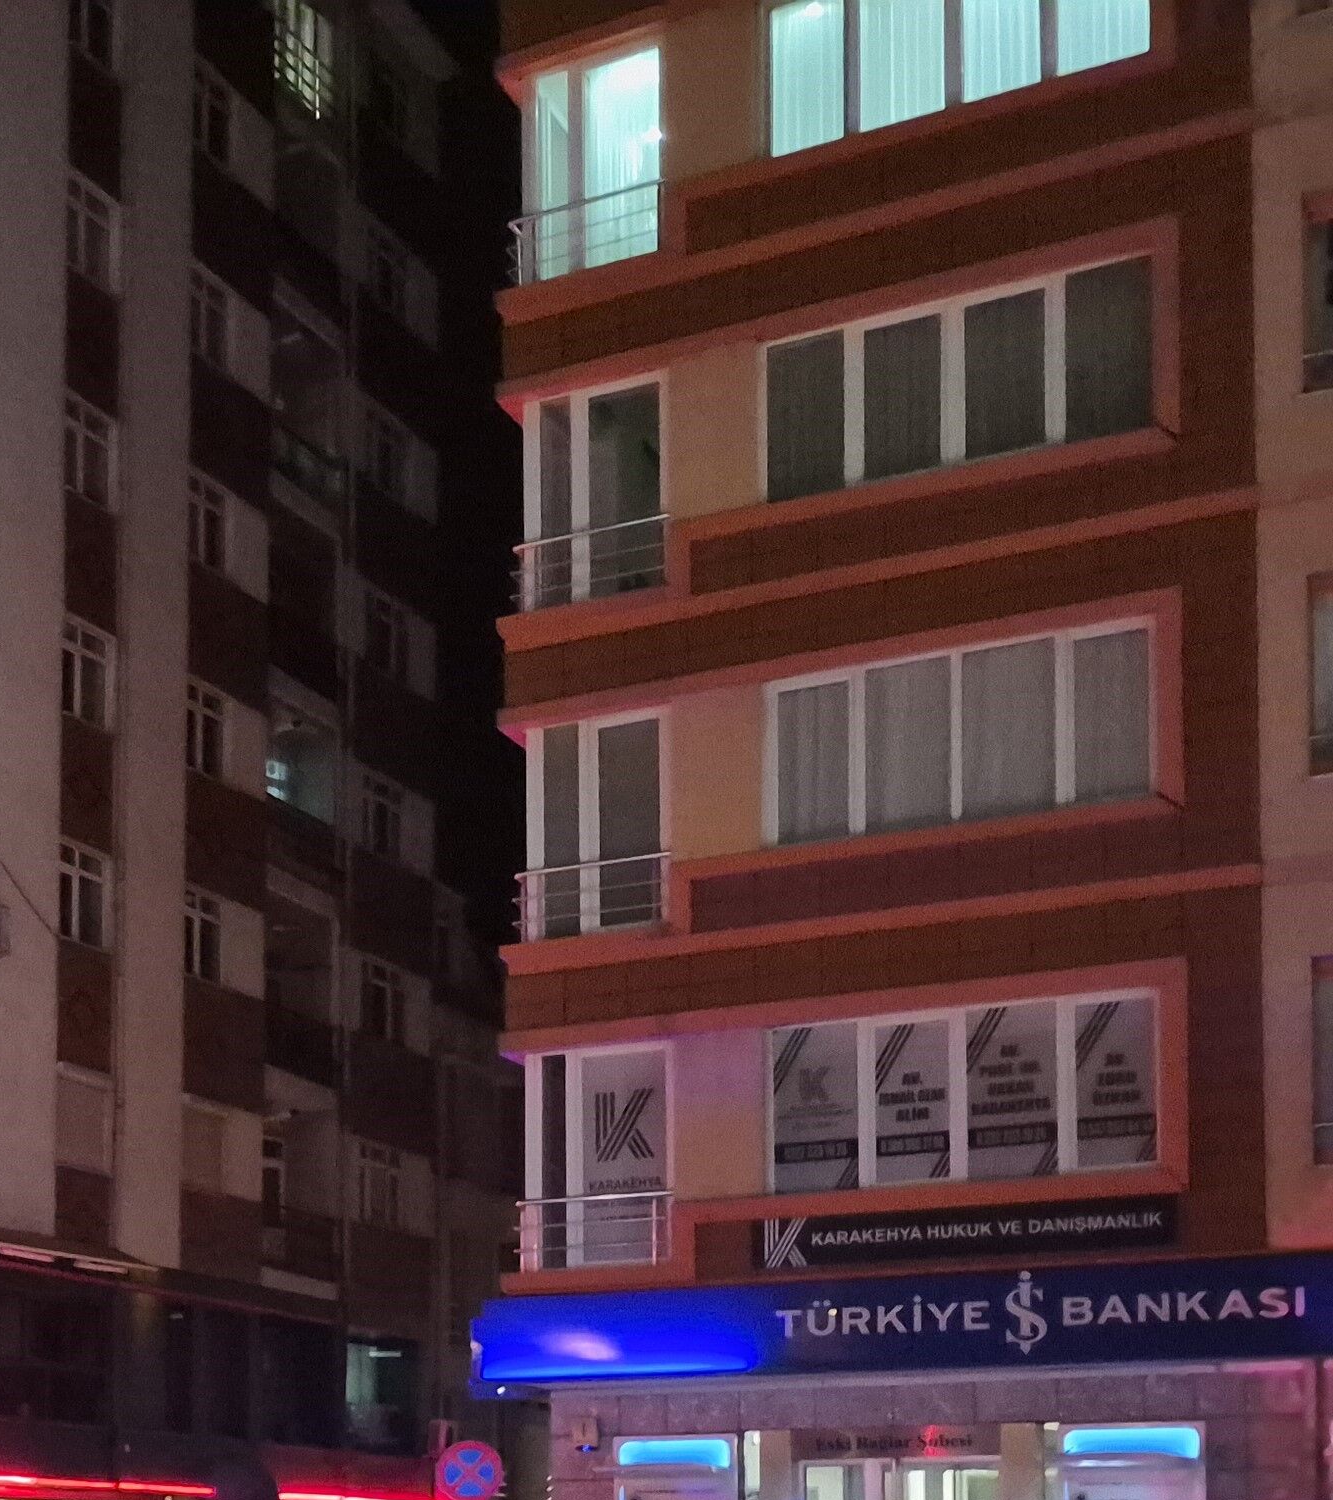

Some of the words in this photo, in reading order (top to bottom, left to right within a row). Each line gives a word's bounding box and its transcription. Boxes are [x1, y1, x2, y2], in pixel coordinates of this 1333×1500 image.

[810, 1225, 923, 1247] KARAKEHYA
[926, 1222, 993, 1240] HUKUK
[998, 1220, 1022, 1236] VE
[1027, 1211, 1164, 1235] DANIŞMANLIK
[775, 1295, 991, 1339] TÜRKİYE
[1061, 1285, 1306, 1327] BANKASI
